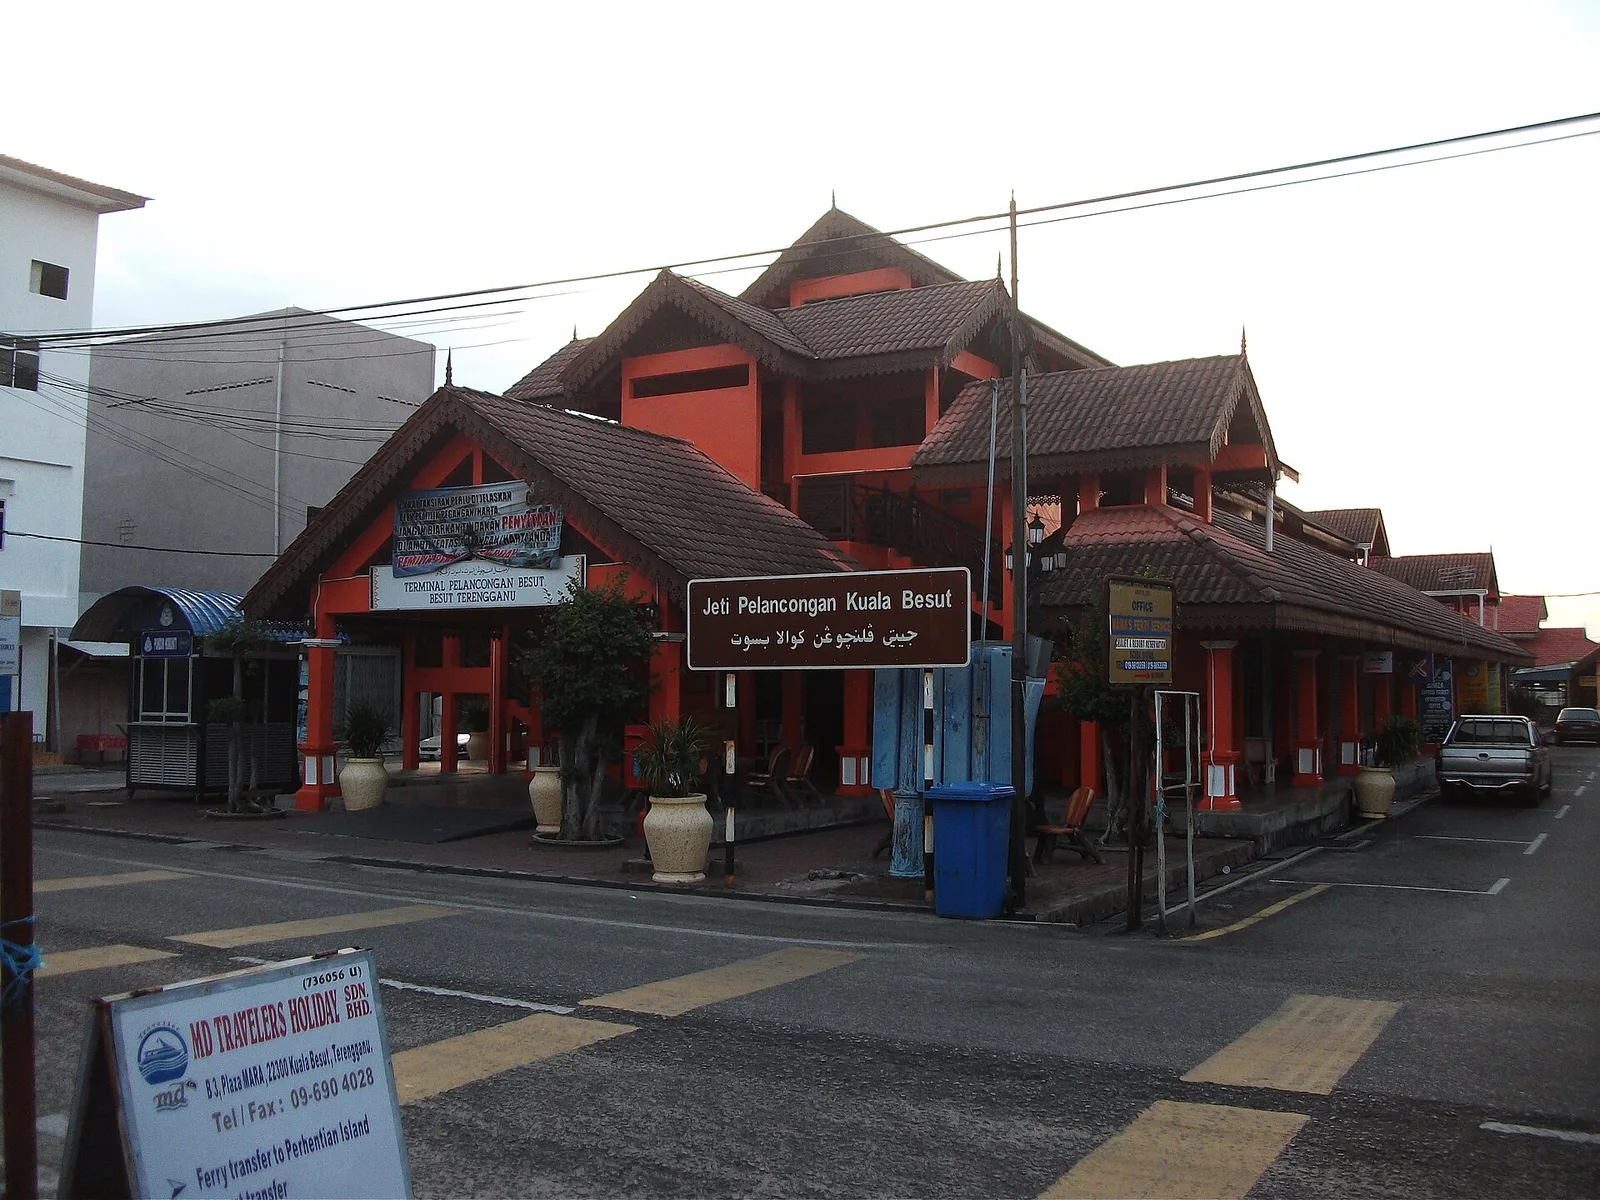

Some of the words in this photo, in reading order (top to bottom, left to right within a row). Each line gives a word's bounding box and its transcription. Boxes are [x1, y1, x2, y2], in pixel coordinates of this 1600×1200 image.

[450, 495, 470, 506] PERLU
[427, 523, 460, 536] BIARKAN
[501, 510, 557, 530] PENYITAAN
[398, 541, 406, 552] DI
[404, 580, 445, 593] TERMINAL
[449, 577, 514, 591] PELANCONGAN
[518, 575, 545, 588] BESUT
[429, 593, 454, 604] BESUT
[456, 590, 516, 603] TERENGGANU
[703, 597, 729, 615] Jeti
[738, 595, 837, 617] Pelancongan
[846, 591, 891, 611] Kuala
[902, 589, 952, 609] Besut
[1131, 600, 1153, 613] OFFICE
[730, 633, 770, 652] بسوت
[302, 969, 345, 990] (736056
[344, 982, 369, 1002] SDN.
[346, 999, 373, 1020] BHD.
[190, 1018, 214, 1060] MD
[213, 1000, 288, 1053] TRAVELERS
[287, 989, 340, 1034] HOLIDAY
[221, 1073, 243, 1096] Plaza
[241, 1065, 269, 1088] MARA,
[266, 1057, 289, 1082] 22300
[288, 1054, 310, 1076] Kuala
[309, 1047, 334, 1069] Besut,
[331, 1039, 374, 1063] Terengganu.
[212, 1108, 238, 1133] Tel
[240, 1104, 245, 1126] /
[248, 1099, 276, 1123] Fax
[290, 1076, 339, 1110] 09-690
[341, 1066, 375, 1093] 4028
[196, 1164, 229, 1191] Ferry
[228, 1148, 272, 1181] transfer
[272, 1144, 285, 1164] to
[284, 1127, 339, 1161] Perhentian
[338, 1113, 370, 1142] Island
